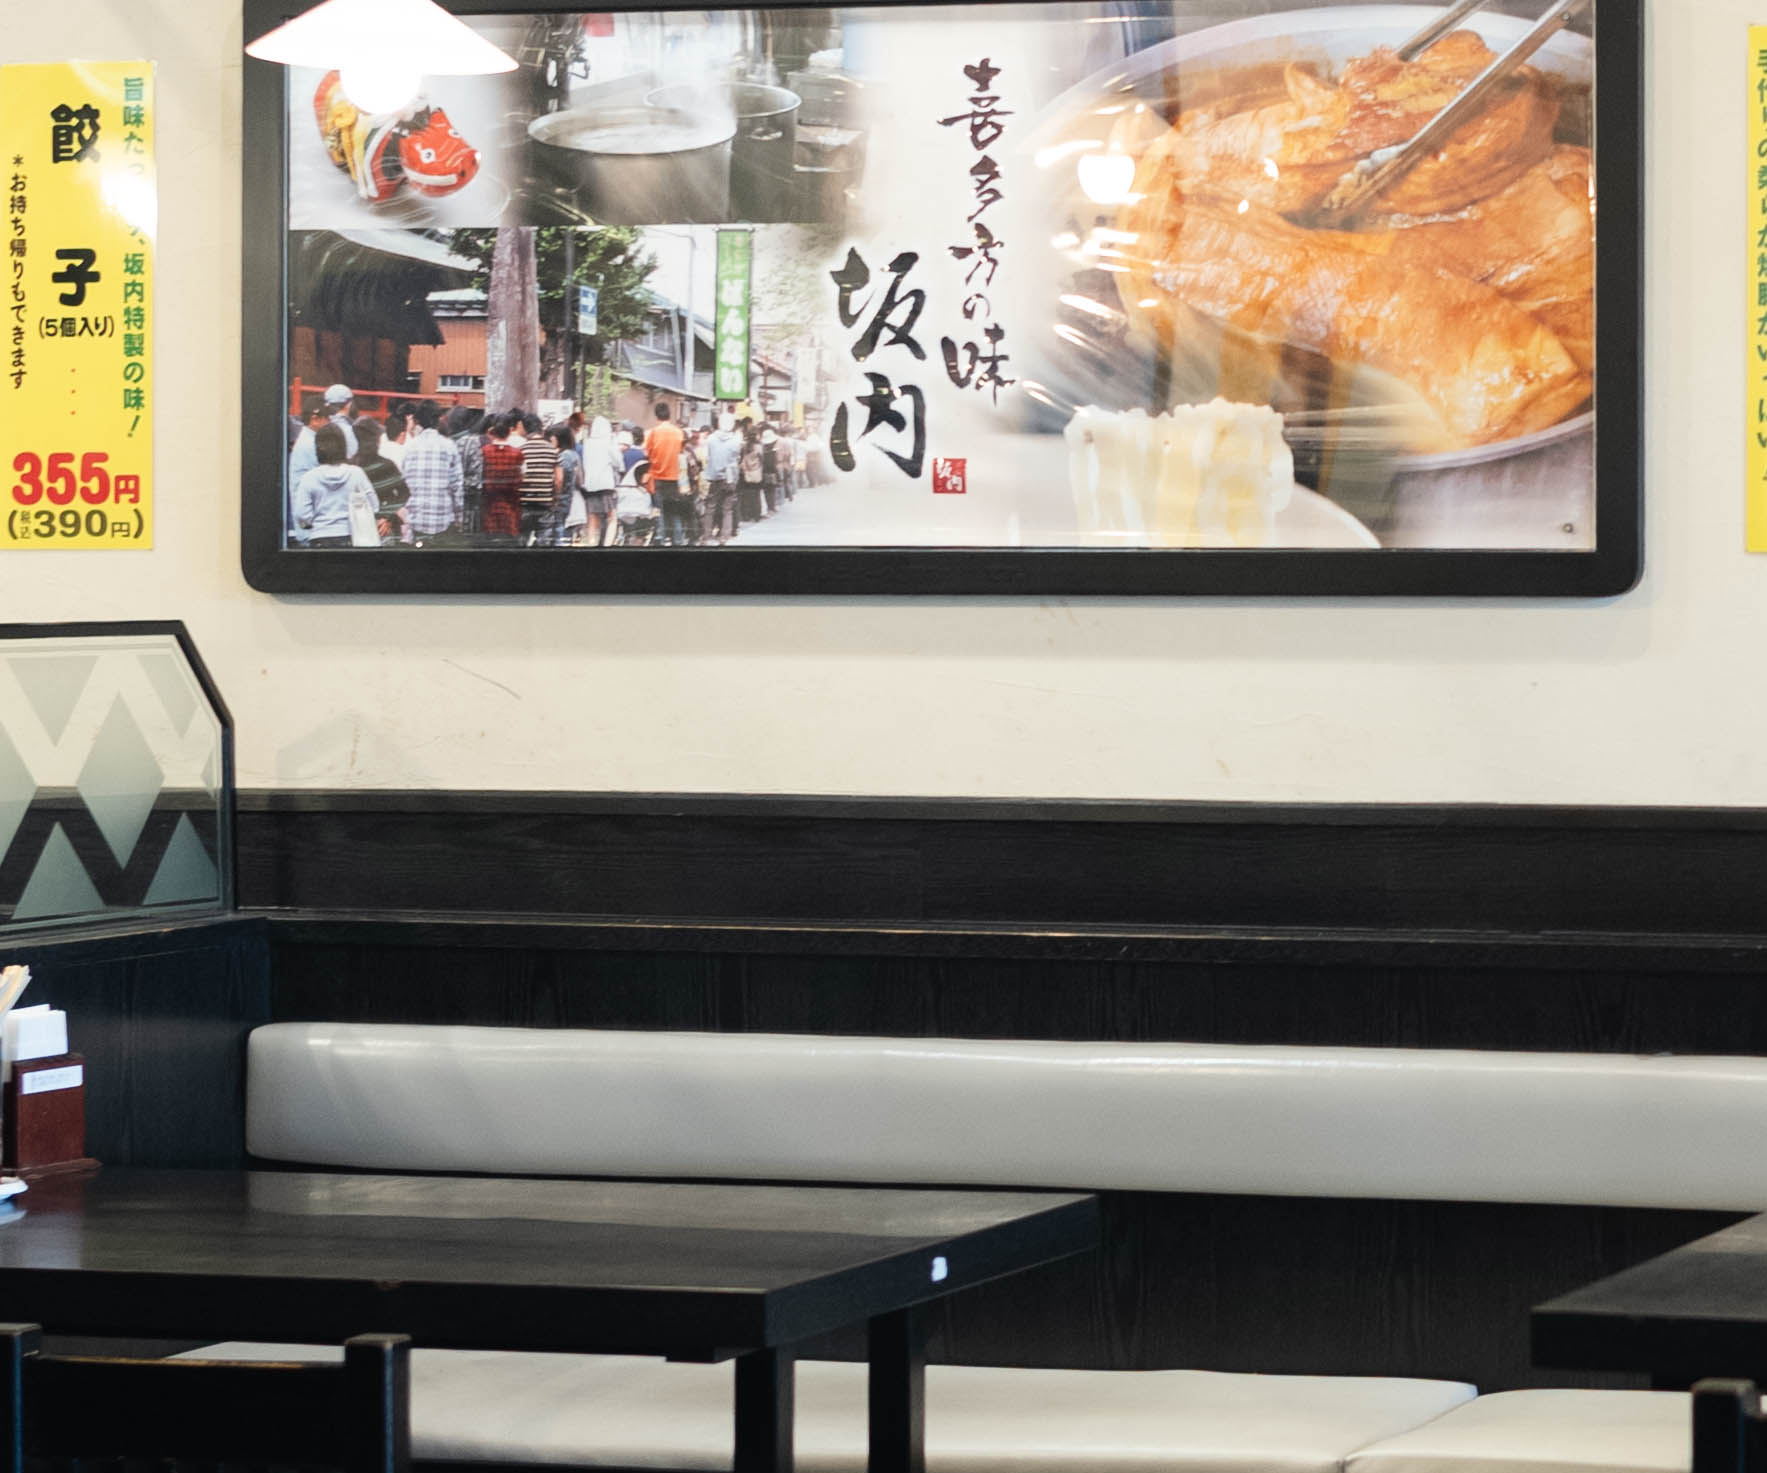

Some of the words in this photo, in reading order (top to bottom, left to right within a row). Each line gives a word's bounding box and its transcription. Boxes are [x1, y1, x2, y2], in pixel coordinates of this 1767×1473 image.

[50, 103, 102, 307] 餃子
[122, 76, 146, 438] 旨味たっ、坂内特製の味！
[829, 246, 928, 479] 坂内
[12, 451, 140, 506] 355円
